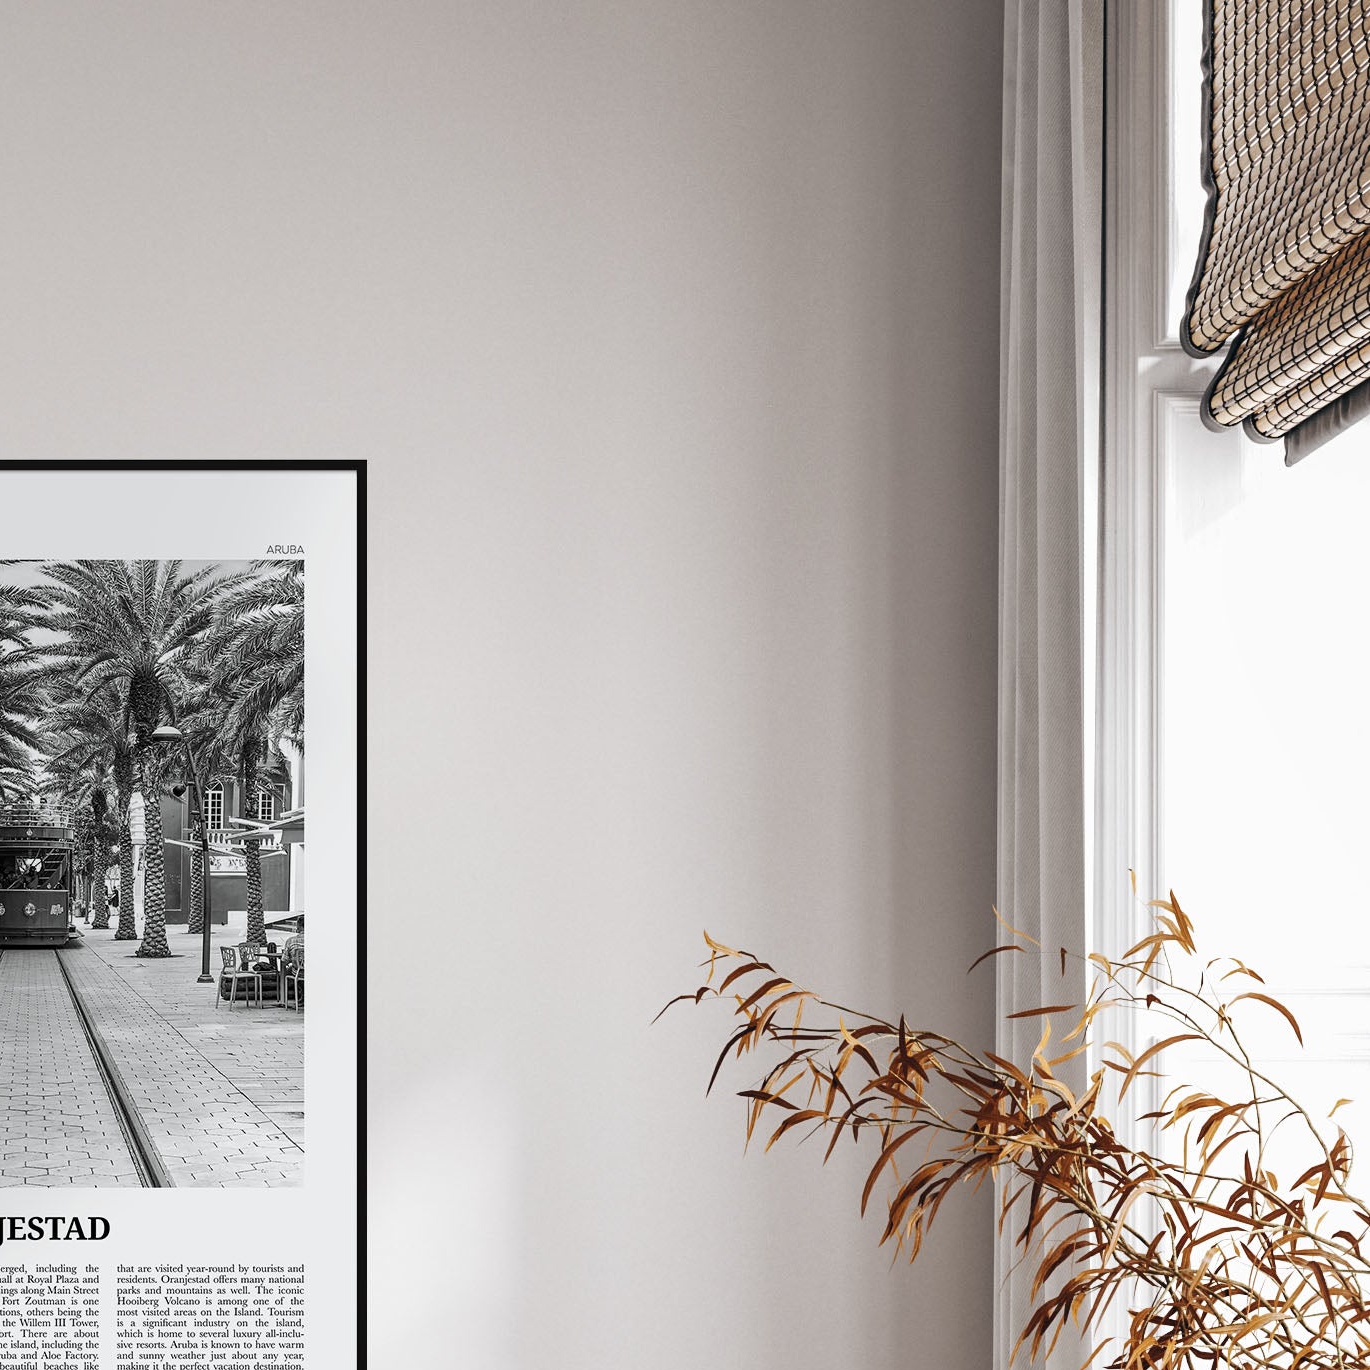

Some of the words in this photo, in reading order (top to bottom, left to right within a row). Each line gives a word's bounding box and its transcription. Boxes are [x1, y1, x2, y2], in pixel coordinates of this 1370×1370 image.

[266, 545, 305, 554] ARUBA
[36, 1264, 77, 1274] including
[85, 1264, 99, 1273] the
[117, 1264, 135, 1273] that
[154, 1264, 183, 1273] visited
[186, 1264, 235, 1274] year-round
[238, 1264, 250, 1274] by
[252, 1264, 285, 1273] tourists
[287, 1264, 305, 1273] and
[20, 1286, 45, 1296] along
[47, 1286, 71, 1294] Main
[73, 1286, 99, 1294] Street
[116, 1286, 141, 1296] parks
[144, 1286, 162, 1294] and
[166, 1286, 213, 1294] mountains
[230, 1286, 251, 1294] well.
[254, 1286, 274, 1294] The
[278, 1286, 304, 1294] iconic
[26, 1308, 54, 1316] others
[56, 1308, 82, 1318] being
[85, 1308, 100, 1316] the
[117, 1308, 138, 1316] most
[141, 1308, 170, 1316] visited
[216, 1308, 230, 1316] the
[234, 1308, 264, 1316] Island.
[267, 1308, 305, 1316] Tourism
[20, 1329, 48, 1338] There
[73, 1329, 99, 1338] about
[116, 1329, 143, 1338] which
[147, 1329, 154, 1338] is
[158, 1329, 183, 1338] home
[186, 1329, 196, 1338] to
[199, 1329, 229, 1338] several
[233, 1329, 262, 1340] luxury
[265, 1329, 305, 1338] all-inclu-
[20, 1351, 38, 1359] and
[40, 1351, 62, 1359] Aloe
[65, 1351, 99, 1361] Factory.
[116, 1351, 134, 1359] and
[138, 1353, 165, 1361] sunny
[170, 1351, 206, 1359] weather
[210, 1351, 227, 1361] just
[231, 1351, 258, 1359] about
[262, 1353, 279, 1361] any
[283, 1353, 305, 1361] year,
